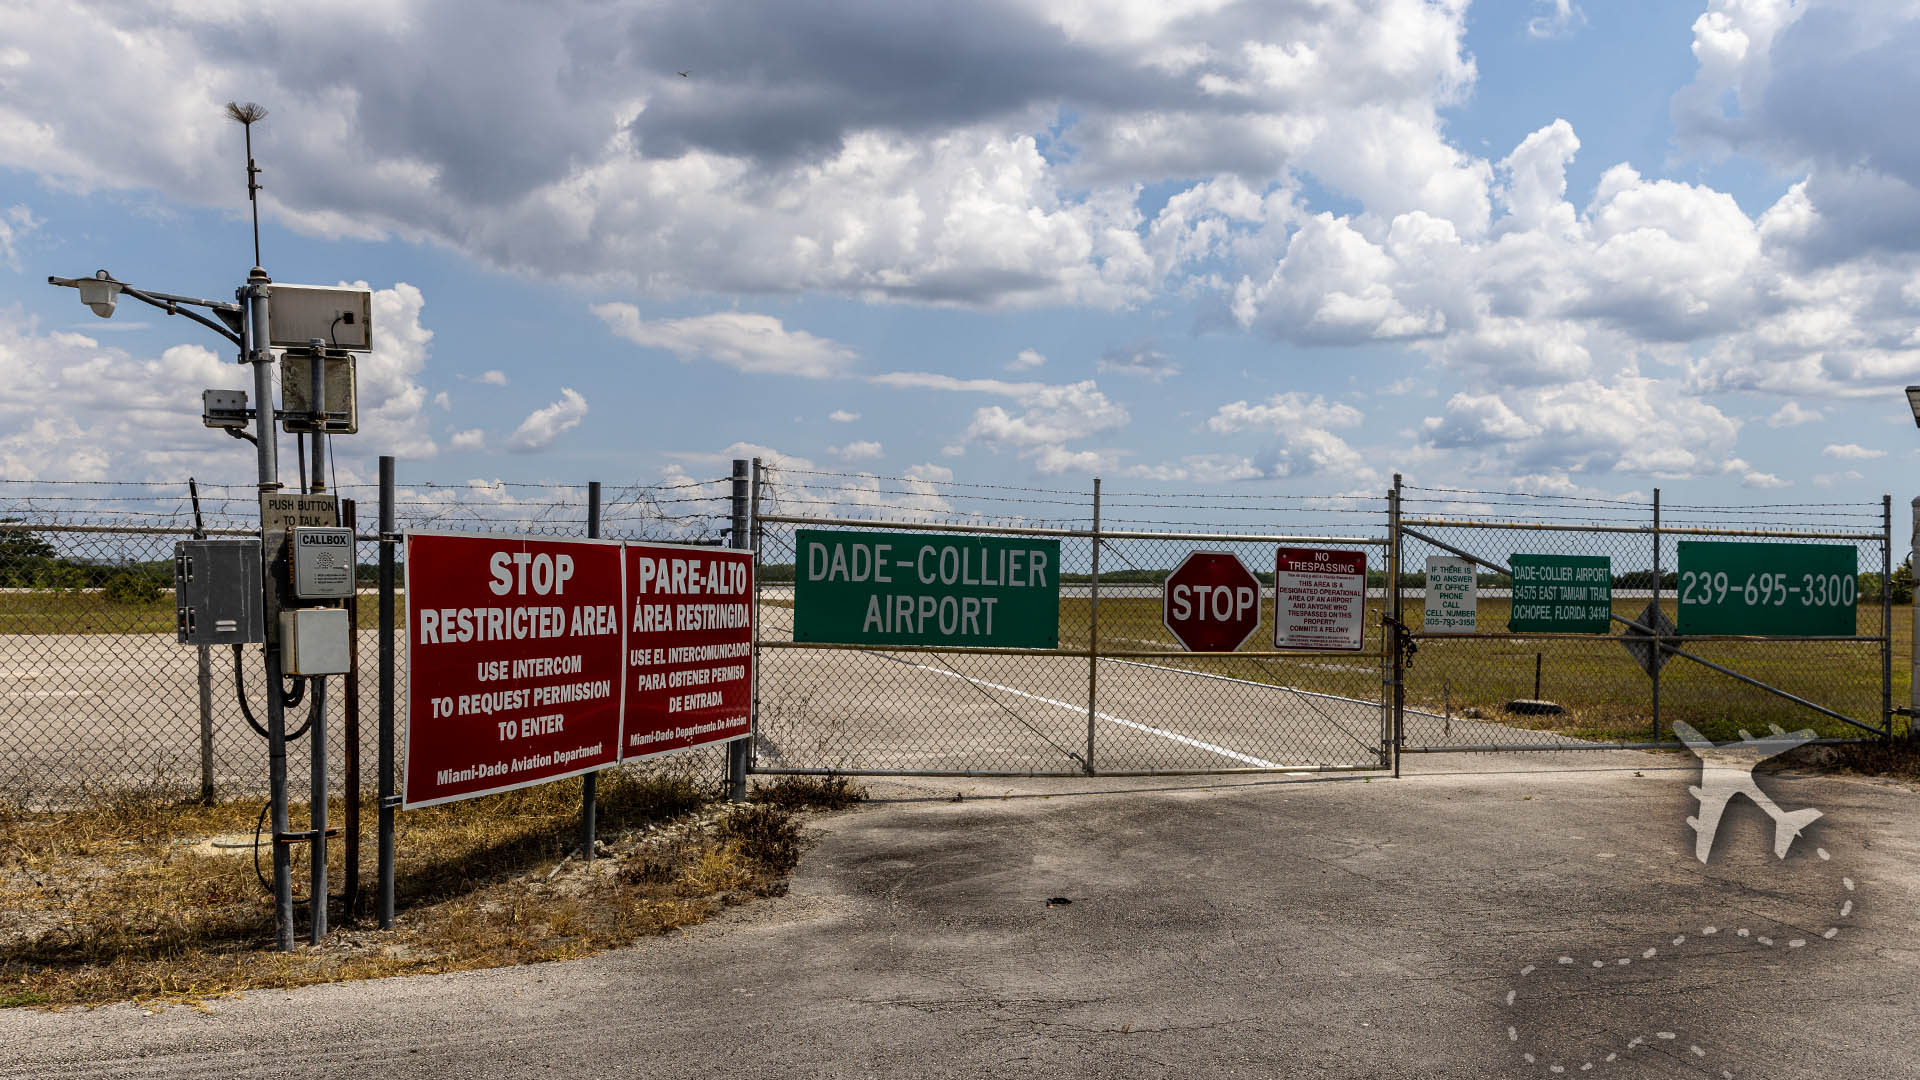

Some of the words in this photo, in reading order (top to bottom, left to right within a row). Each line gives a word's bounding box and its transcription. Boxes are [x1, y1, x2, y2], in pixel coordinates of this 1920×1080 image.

[269, 499, 294, 511] PUSH
[297, 500, 334, 512] BUTTON
[284, 515, 296, 526] TO
[300, 515, 321, 527] TALK
[302, 535, 347, 545] CALLBOX
[807, 542, 1048, 588] DADE-COLLIER
[1288, 561, 1355, 573] TRESPASSING
[1315, 552, 1330, 562] NO
[488, 552, 575, 596] STOP
[639, 557, 747, 595] PARE-ALTO
[1440, 566, 1462, 574] THERE
[1464, 567, 1472, 575] IS
[1514, 566, 1573, 581] DADE-COLLIER
[1575, 567, 1609, 582] AIRPORT
[1279, 587, 1318, 595] DESIGNATED
[1319, 588, 1362, 597] OPERATIONAL
[1445, 584, 1470, 592] OFFICE
[1514, 585, 1537, 600] 54575
[1538, 586, 1557, 601] EAST
[1559, 586, 1588, 601] TAMIAMI
[1589, 587, 1609, 601] TRAIL
[1682, 571, 1855, 606] 239-695-3300
[1172, 584, 1254, 622] STOP
[1307, 603, 1333, 611] ANYONE
[1326, 596, 1353, 604] AIRPORT
[632, 595, 673, 632] ÁREA
[676, 603, 750, 631] RESTRINGIDA
[862, 594, 998, 636] AIRPORT
[1288, 610, 1327, 618] TRESPASSES
[1446, 610, 1476, 618] NUMBER
[1513, 604, 1553, 621] OCHOPEE,
[1554, 605, 1586, 620] FLORIDA
[1588, 606, 1609, 620] 34141
[420, 607, 566, 644] RESTRICTED
[570, 605, 618, 637] AREA
[630, 649, 652, 666] USE
[653, 648, 666, 665] EL
[668, 642, 751, 664] INTERCOMUNICADOR
[477, 660, 509, 682] USE
[513, 655, 582, 679] INTERCOM
[638, 673, 667, 692] PARA
[668, 668, 710, 688] OBTENER
[711, 664, 745, 683] PERMISO
[431, 697, 454, 718] TO
[458, 689, 530, 715] REQUEST
[533, 680, 611, 706] PERMISSION
[668, 696, 683, 713] DE
[684, 691, 723, 711] ENTRADA
[498, 721, 518, 741] TO
[521, 714, 564, 737] ENTER
[630, 728, 674, 747] Miami-Dade
[717, 719, 725, 730] De
[436, 761, 508, 786] Miami-Dade
[510, 751, 552, 773] Aviation
[553, 742, 603, 766] Department
